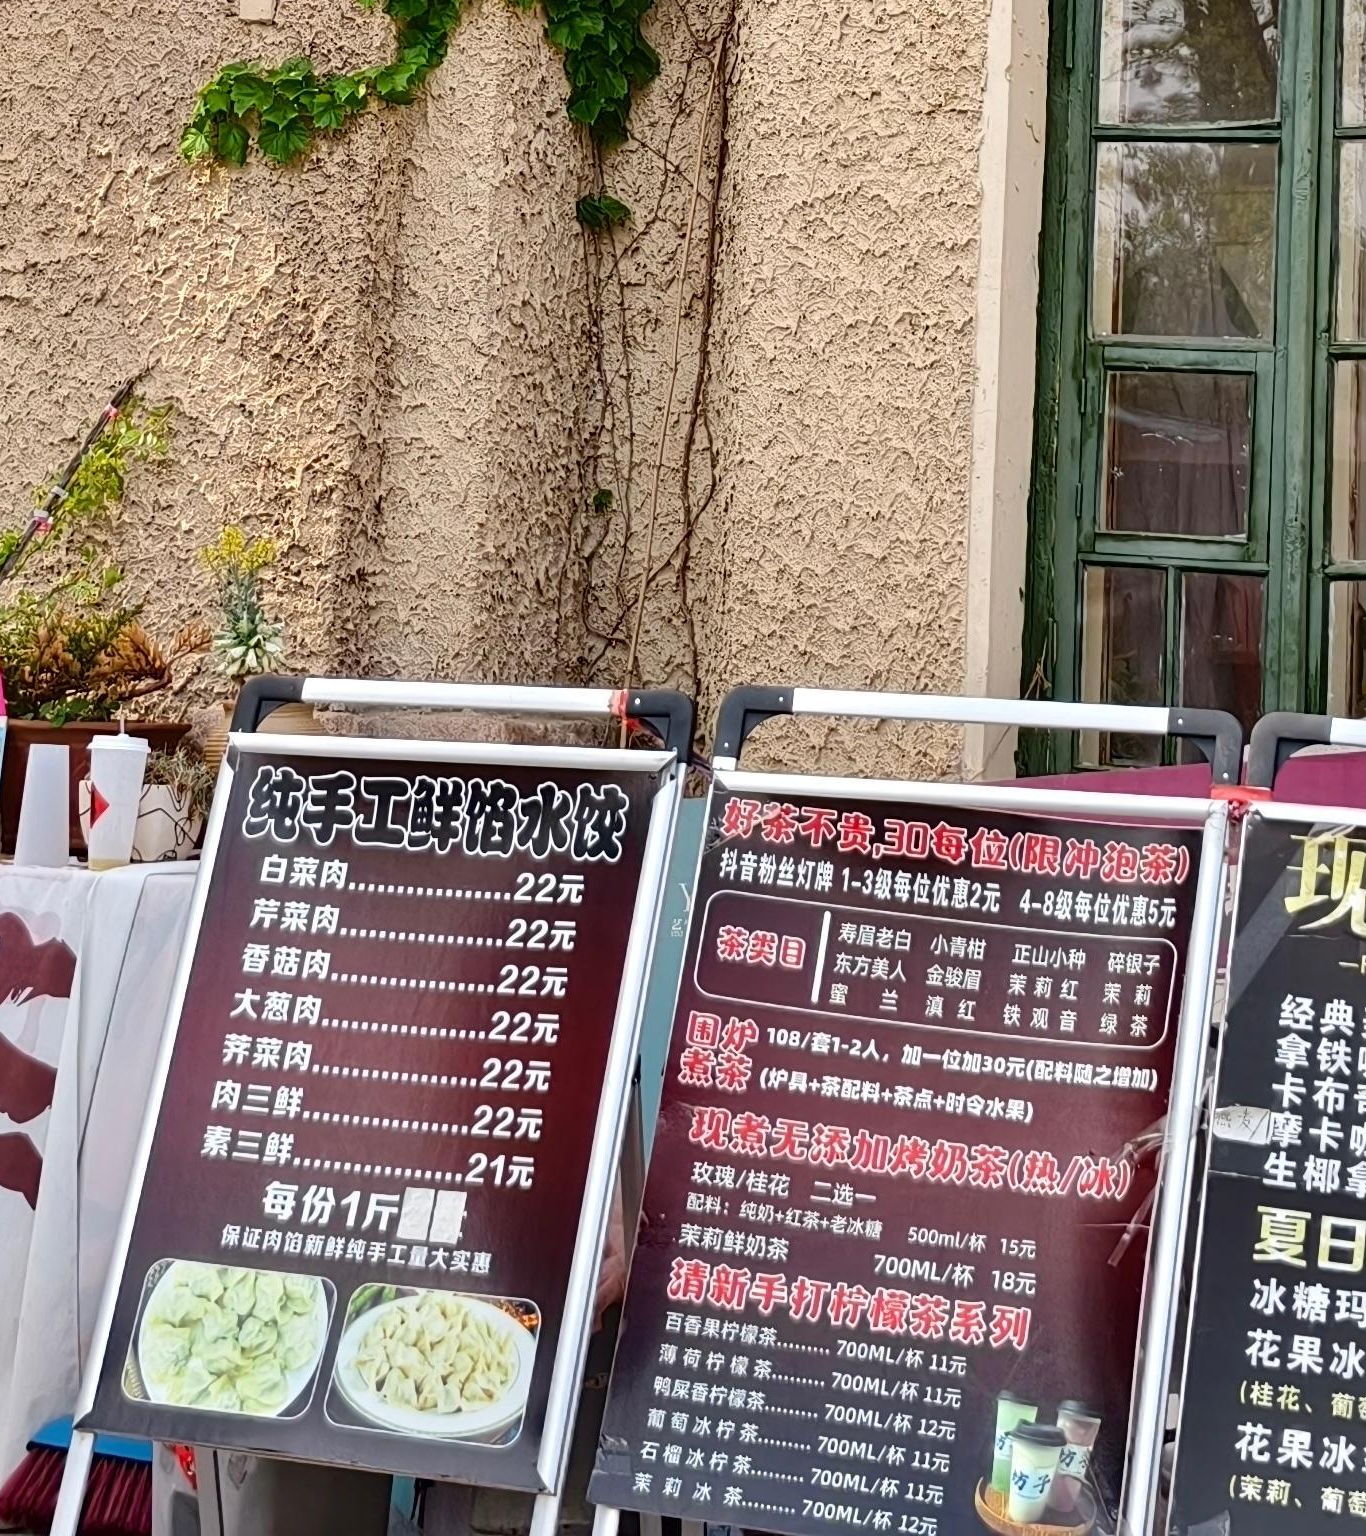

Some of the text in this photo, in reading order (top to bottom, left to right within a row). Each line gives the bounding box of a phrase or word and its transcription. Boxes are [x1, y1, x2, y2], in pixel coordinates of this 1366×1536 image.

[243, 766, 630, 862] 纯手工鲜馅水饺
[258, 854, 586, 905] 白菜肉 22元
[719, 847, 1177, 929] 抖音粉丝灯牌 1-3级每位优惠2元 4-8级每位优惠5元
[249, 898, 577, 951] 芹菜肉 22元
[717, 925, 807, 970] 茶类目
[838, 922, 1161, 977] 寿眉老白 小青柑 正山小种 碎银子
[241, 943, 569, 998] 香菇肉 22元
[833, 953, 1153, 1007] 东方美人 金骏眉 茉莉红 茉莉
[230, 988, 560, 1045] 大葱肉 22元
[685, 1010, 759, 1054] 围炉
[1002, 1003, 1078, 1032] 铁观音
[1100, 1013, 1149, 1038] 绿茶
[221, 1033, 552, 1093] 荠菜肉 22元
[678, 1046, 752, 1093] 煮茶
[211, 1079, 543, 1140] 肉三鲜 22元
[200, 1124, 536, 1188] 素三鲜 21元
[688, 1105, 1134, 1201] 现煮无添加烤奶茶(热/冰)
[690, 1161, 877, 1207] 玫瑰/桂花 二选一
[221, 1223, 493, 1274] 保证肉馅新鲜纯手工量大实惠
[678, 1223, 1038, 1295] 茉莉鲜奶茶 700ML/杯 18元
[907, 1225, 987, 1254] 500ml/杯
[999, 1237, 1038, 1261] 15元
[666, 1256, 1032, 1351] 清新手打柠檬茶系列
[664, 1311, 968, 1377] 百香果柠檬茶 700ML/杯 11元
[658, 1342, 963, 1409] 薄荷柠檬茶 700ML/杯 11元
[652, 1375, 957, 1442] 鸭屎香柠檬茶 700ML/杯 12元
[646, 1407, 951, 1473] 葡萄冰柠茶 700ML/杯 11元
[632, 1471, 743, 1508] 茉莉冰茶
[802, 1499, 893, 1531] 700ML/杯
[639, 1440, 944, 1506] 石榴冰柠茶 700ML/杯 11元
